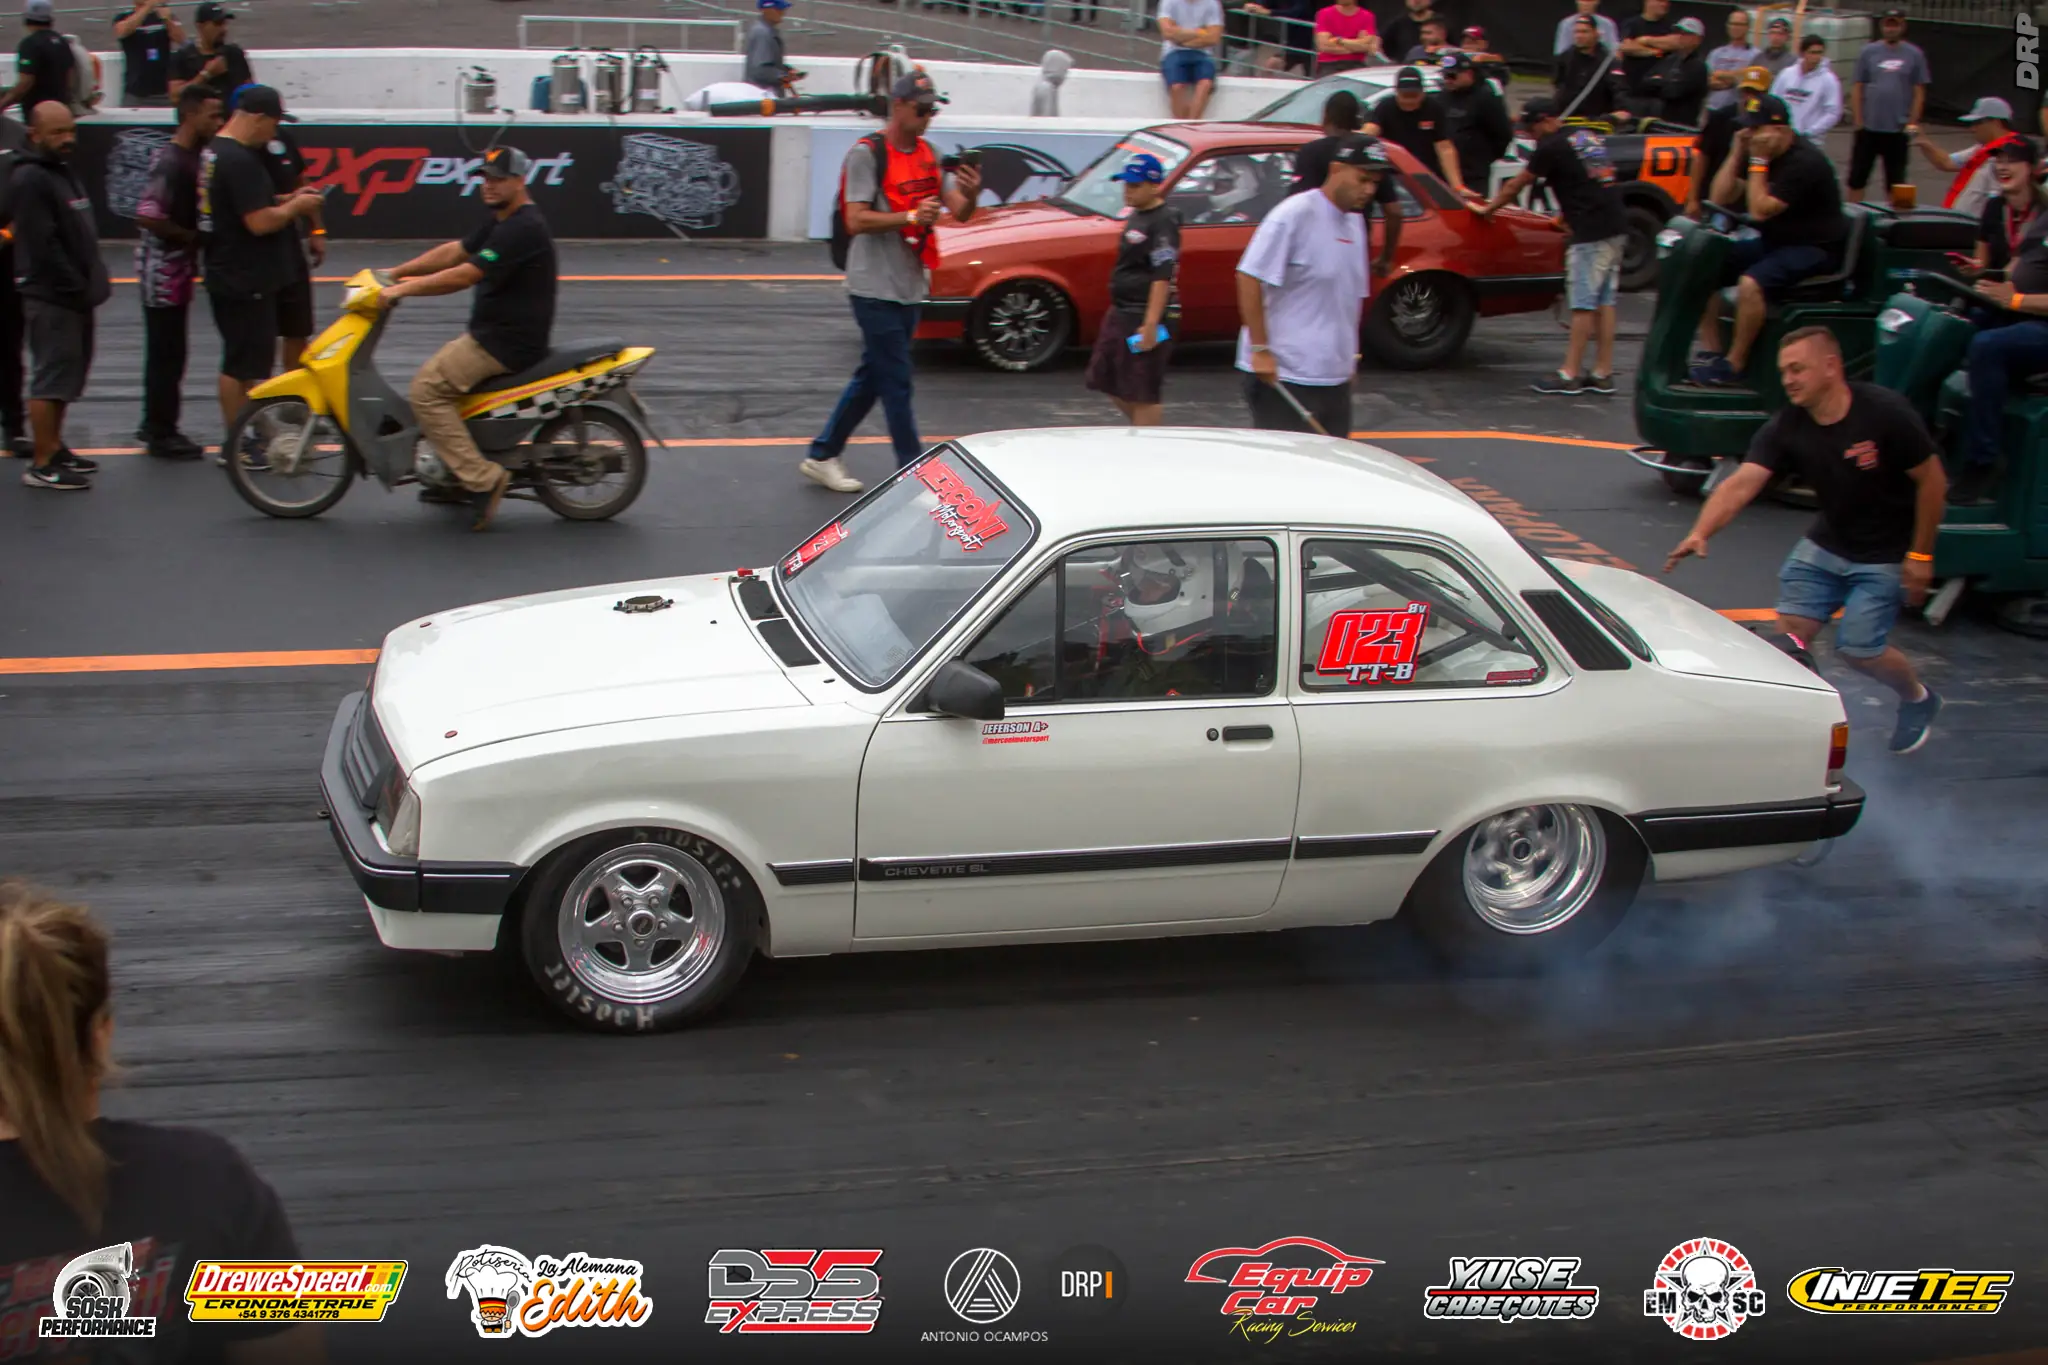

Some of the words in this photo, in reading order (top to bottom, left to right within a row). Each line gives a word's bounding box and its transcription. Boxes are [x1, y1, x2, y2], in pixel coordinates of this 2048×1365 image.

[914, 456, 1010, 541] MERCONI
[929, 503, 984, 552] Motorsport
[1318, 611, 1426, 672] 023
[1345, 662, 1415, 682] TT-B
[982, 723, 1032, 735] JEFERSON
[884, 864, 966, 877] CHEVETTE
[969, 863, 989, 873] SL
